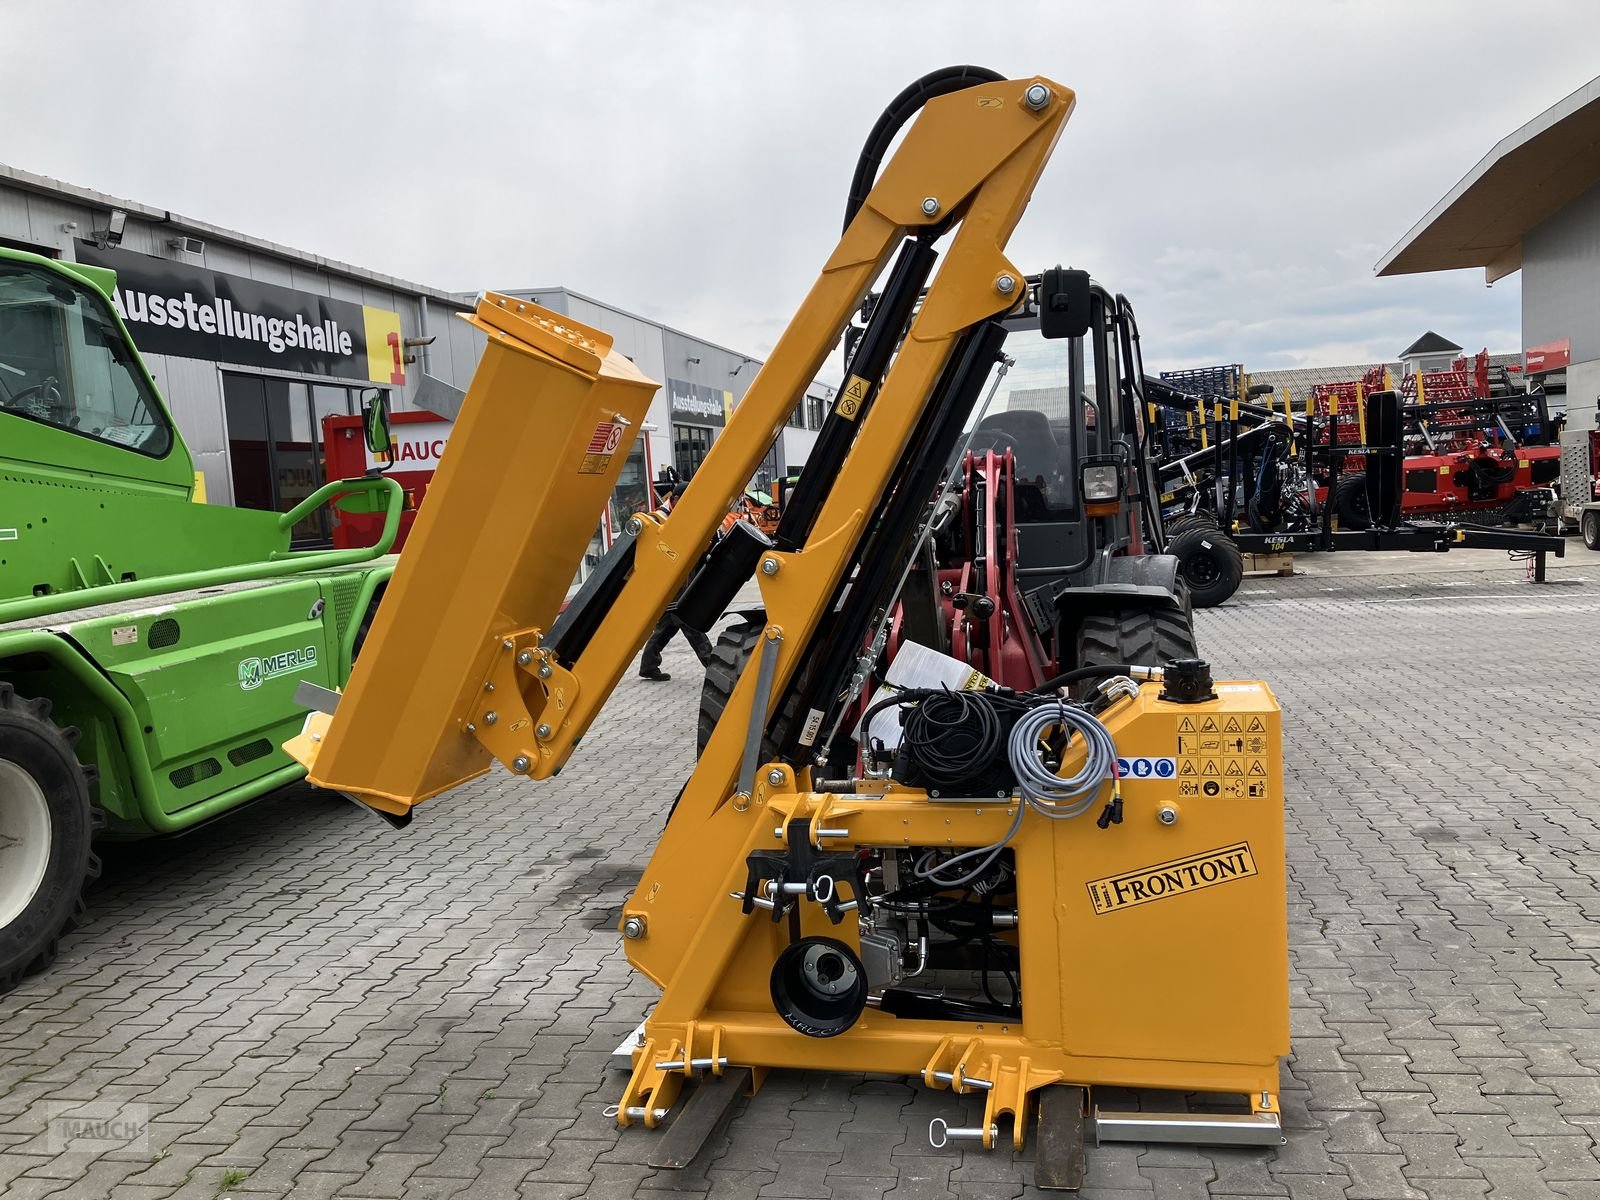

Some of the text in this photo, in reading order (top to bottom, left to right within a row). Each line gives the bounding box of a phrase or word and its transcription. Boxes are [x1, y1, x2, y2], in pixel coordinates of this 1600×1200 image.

[110, 285, 405, 386] Ausstellungshalle 1
[381, 440, 447, 462] MAUC
[1264, 536, 1294, 544] KESLA
[1271, 543, 1285, 551] 104
[263, 646, 316, 674] MERLO
[1109, 846, 1249, 906] FRONTONI
